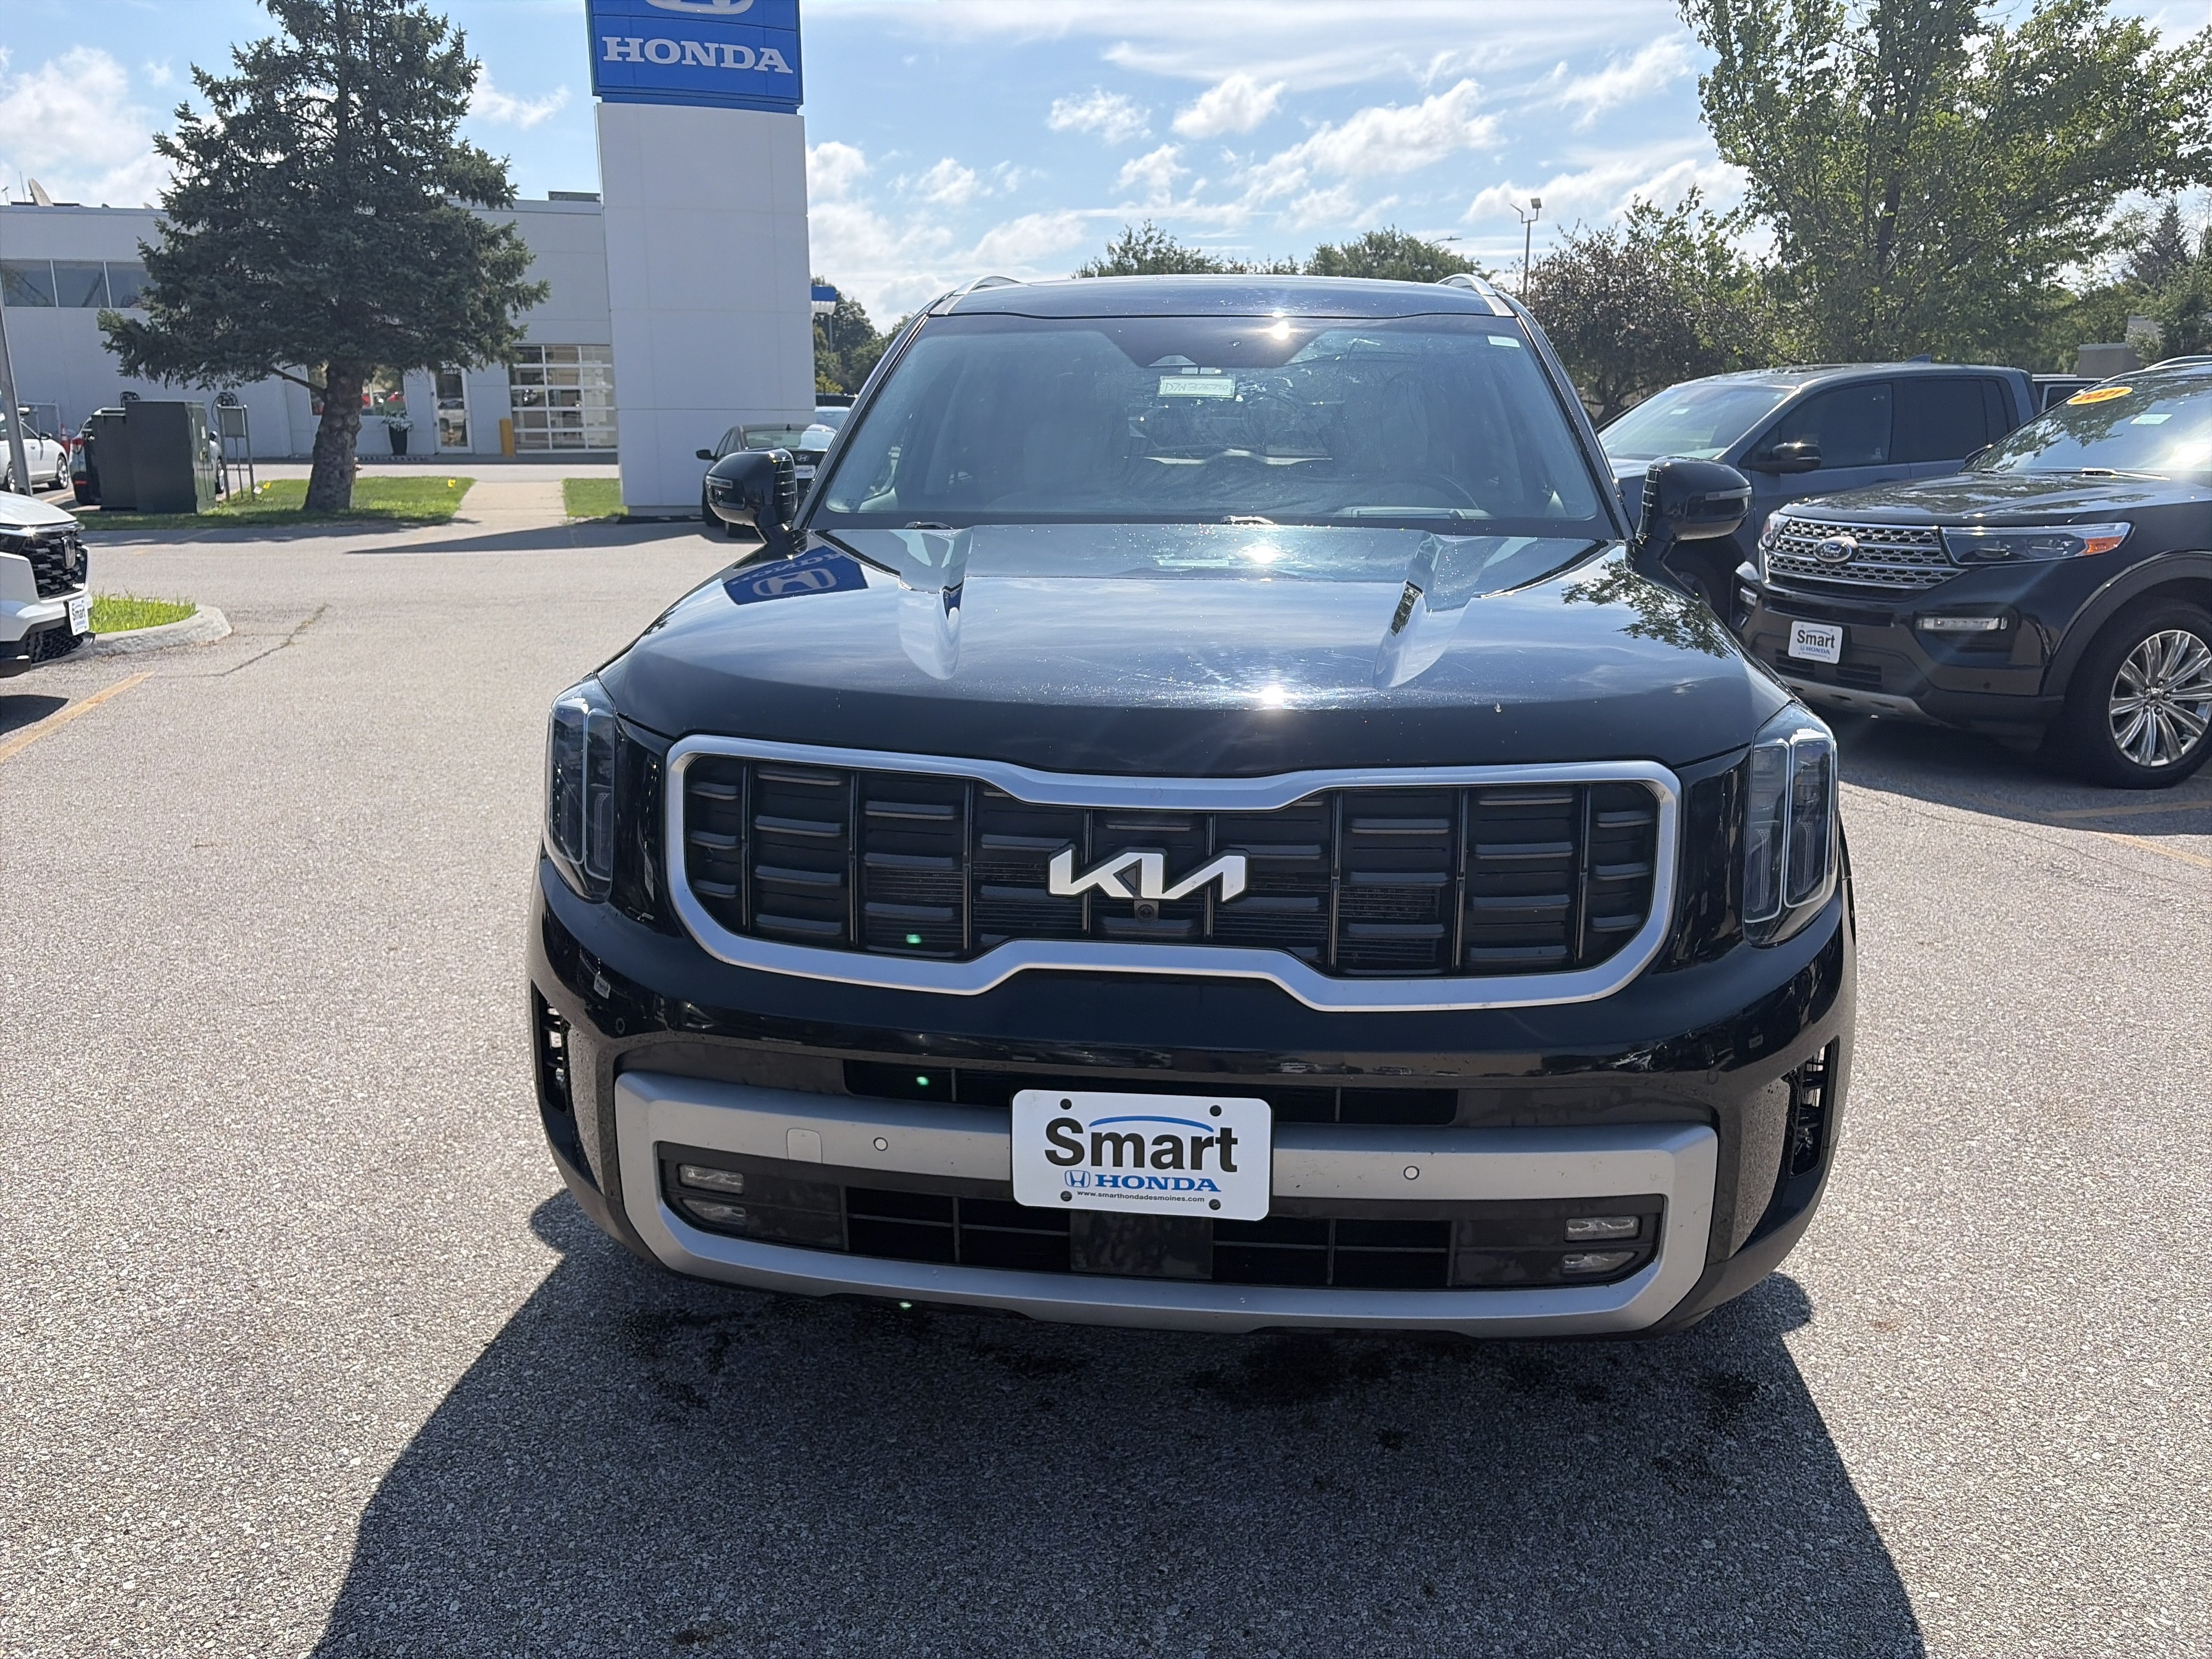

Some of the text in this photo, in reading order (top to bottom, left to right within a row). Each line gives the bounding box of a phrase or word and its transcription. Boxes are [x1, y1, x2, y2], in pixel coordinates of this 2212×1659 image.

[602, 36, 793, 74] HONDA
[72, 605, 86, 621] Smart
[1797, 629, 1835, 648] Smart
[1806, 646, 1830, 654] HONDA
[1049, 849, 1246, 902] KIA
[1045, 1117, 1238, 1172] Smart
[1095, 1174, 1221, 1192] HONDA
[1077, 1190, 1205, 1203] www.smarthondadesmoines.com
